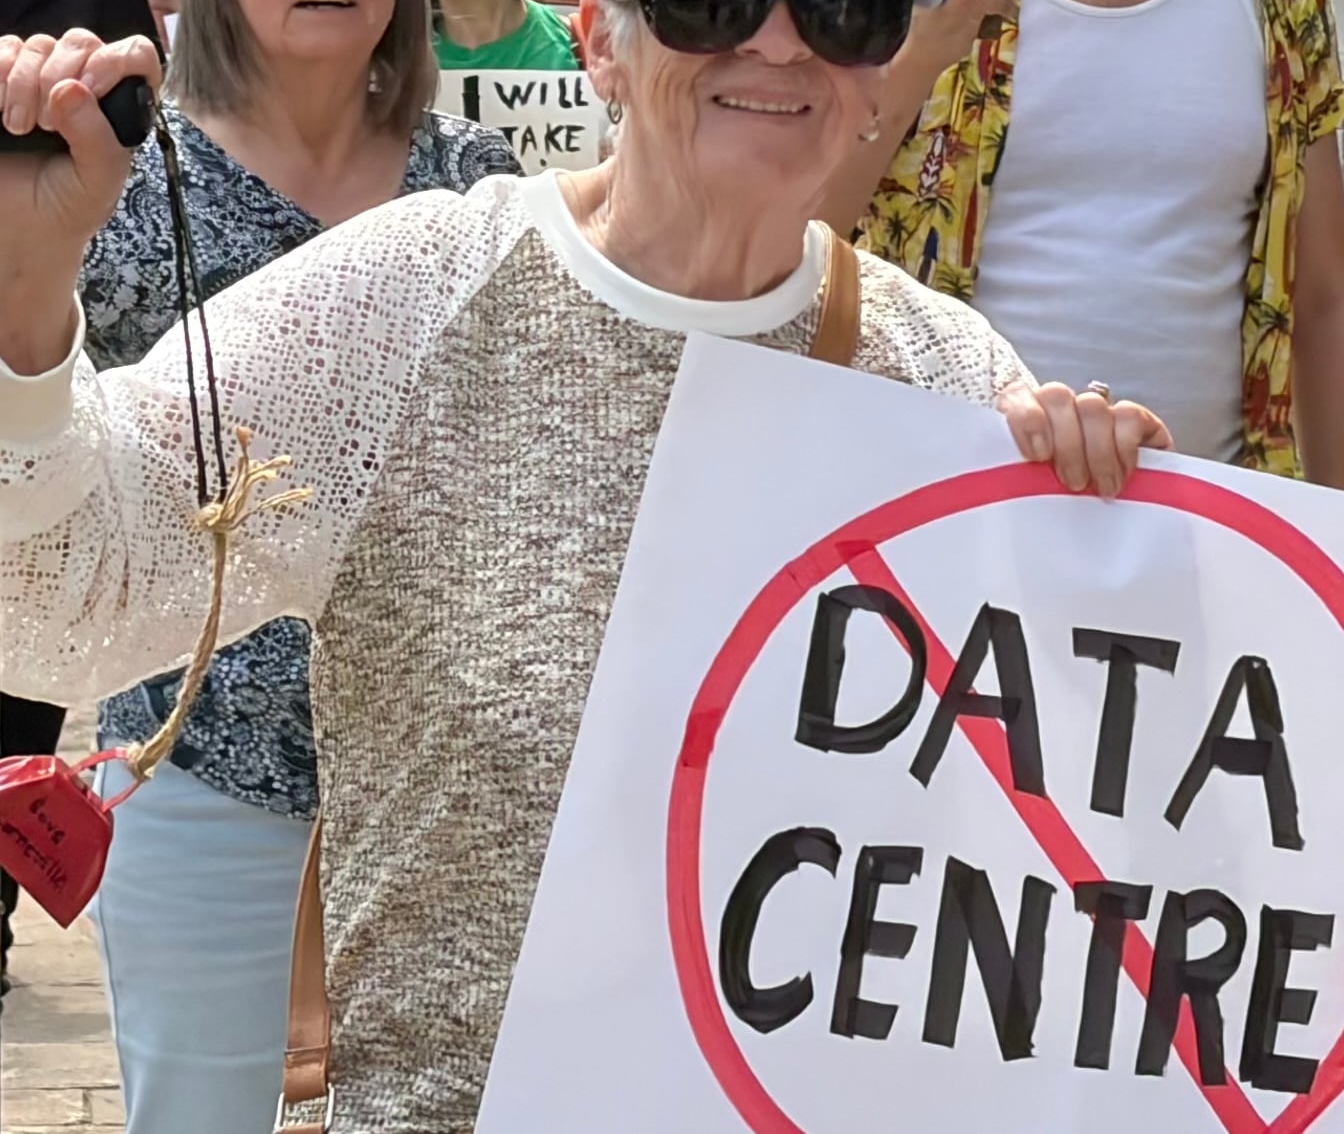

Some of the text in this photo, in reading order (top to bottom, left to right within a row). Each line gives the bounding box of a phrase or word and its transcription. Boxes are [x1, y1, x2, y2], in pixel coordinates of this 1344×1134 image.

[494, 77, 588, 110] WILL
[498, 123, 585, 158] TAKE
[794, 583, 1304, 852] DATA
[718, 826, 1335, 1094] CENTRE
